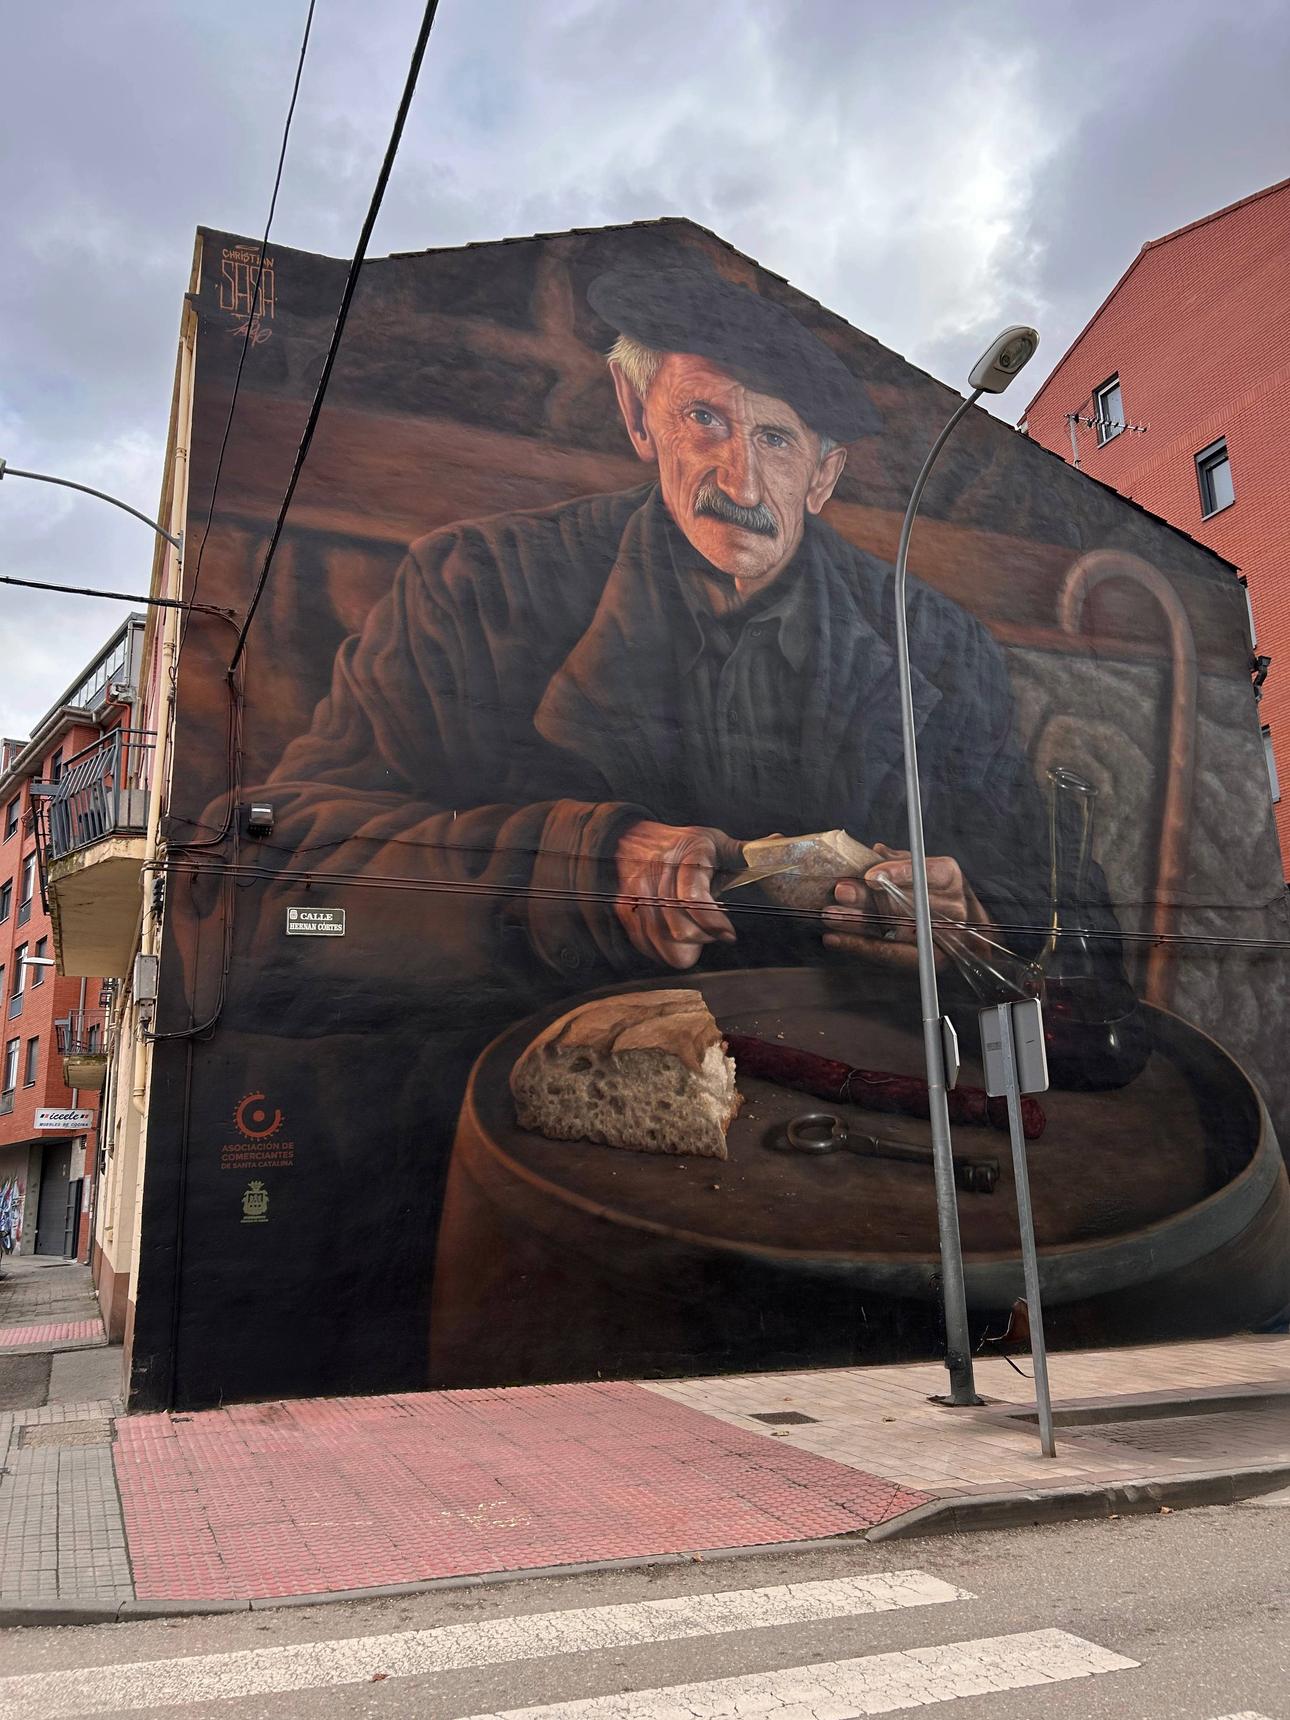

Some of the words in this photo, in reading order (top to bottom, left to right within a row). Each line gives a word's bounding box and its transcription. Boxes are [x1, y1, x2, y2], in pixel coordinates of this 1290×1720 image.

[300, 912, 333, 921] CALLE
[289, 922, 317, 931] HERNAN
[221, 1141, 280, 1152] ASOCIACIÓN
[281, 1141, 295, 1150] DE
[221, 1151, 295, 1162] COMERCIANTES
[220, 1162, 231, 1170] DE
[232, 1161, 257, 1169] SANTA
[257, 1160, 294, 1168] CATALINA
